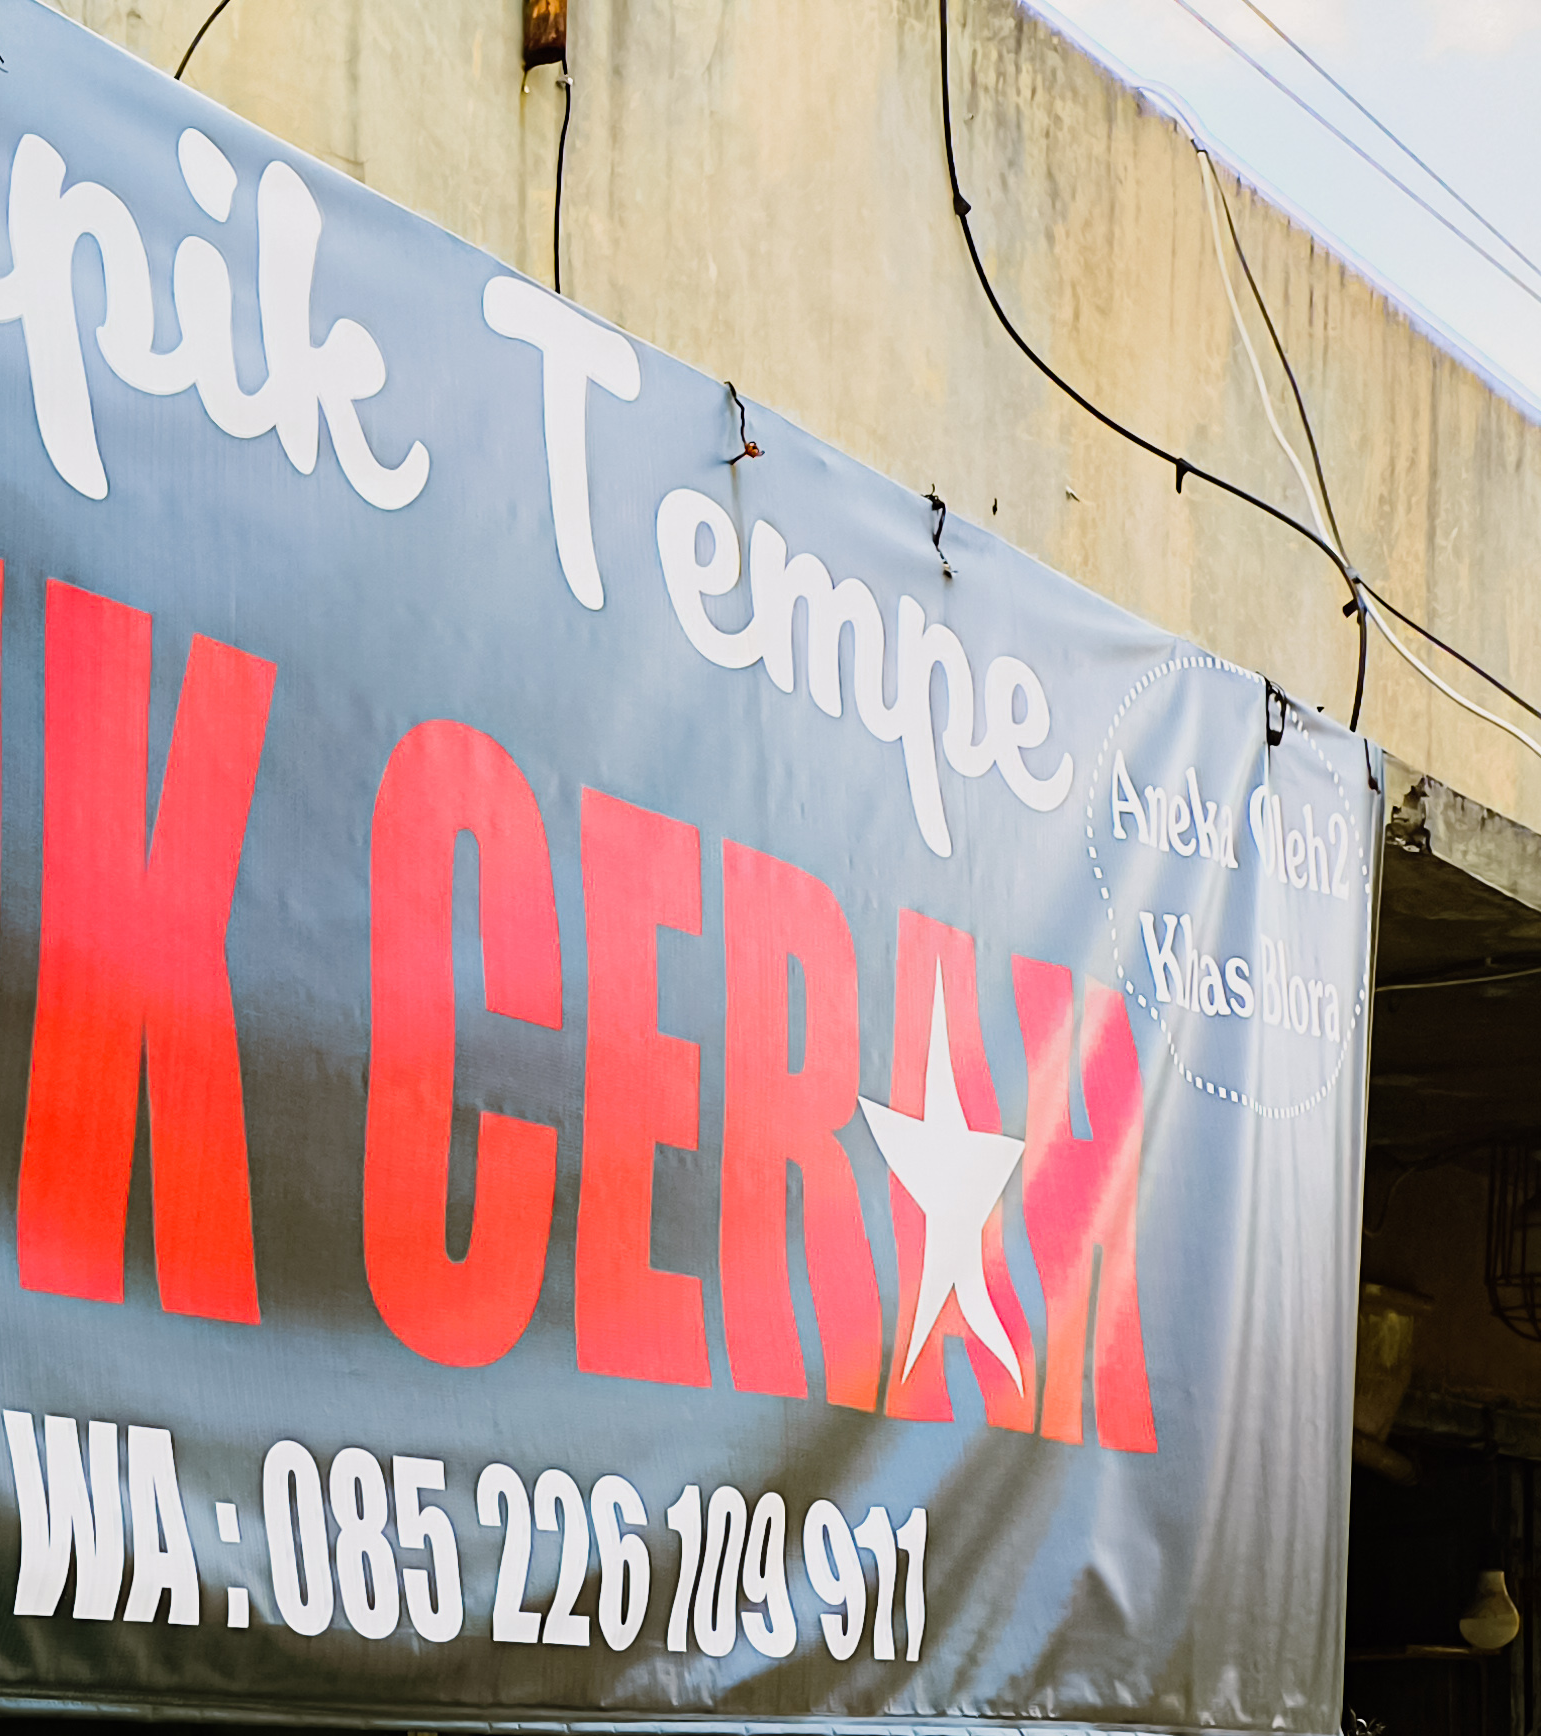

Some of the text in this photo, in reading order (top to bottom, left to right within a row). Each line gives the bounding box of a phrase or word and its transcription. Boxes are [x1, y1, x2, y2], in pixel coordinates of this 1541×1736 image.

[483, 275, 1073, 857] Tempe
[1110, 749, 1238, 869] Aneka
[364, 717, 1157, 1455] CERAH
[1139, 911, 1340, 1042] Khas Blora
[262, 1440, 466, 1642] 085
[477, 1462, 651, 1652] 226
[666, 1484, 788, 1660] 109
[804, 1499, 927, 1663] 911
